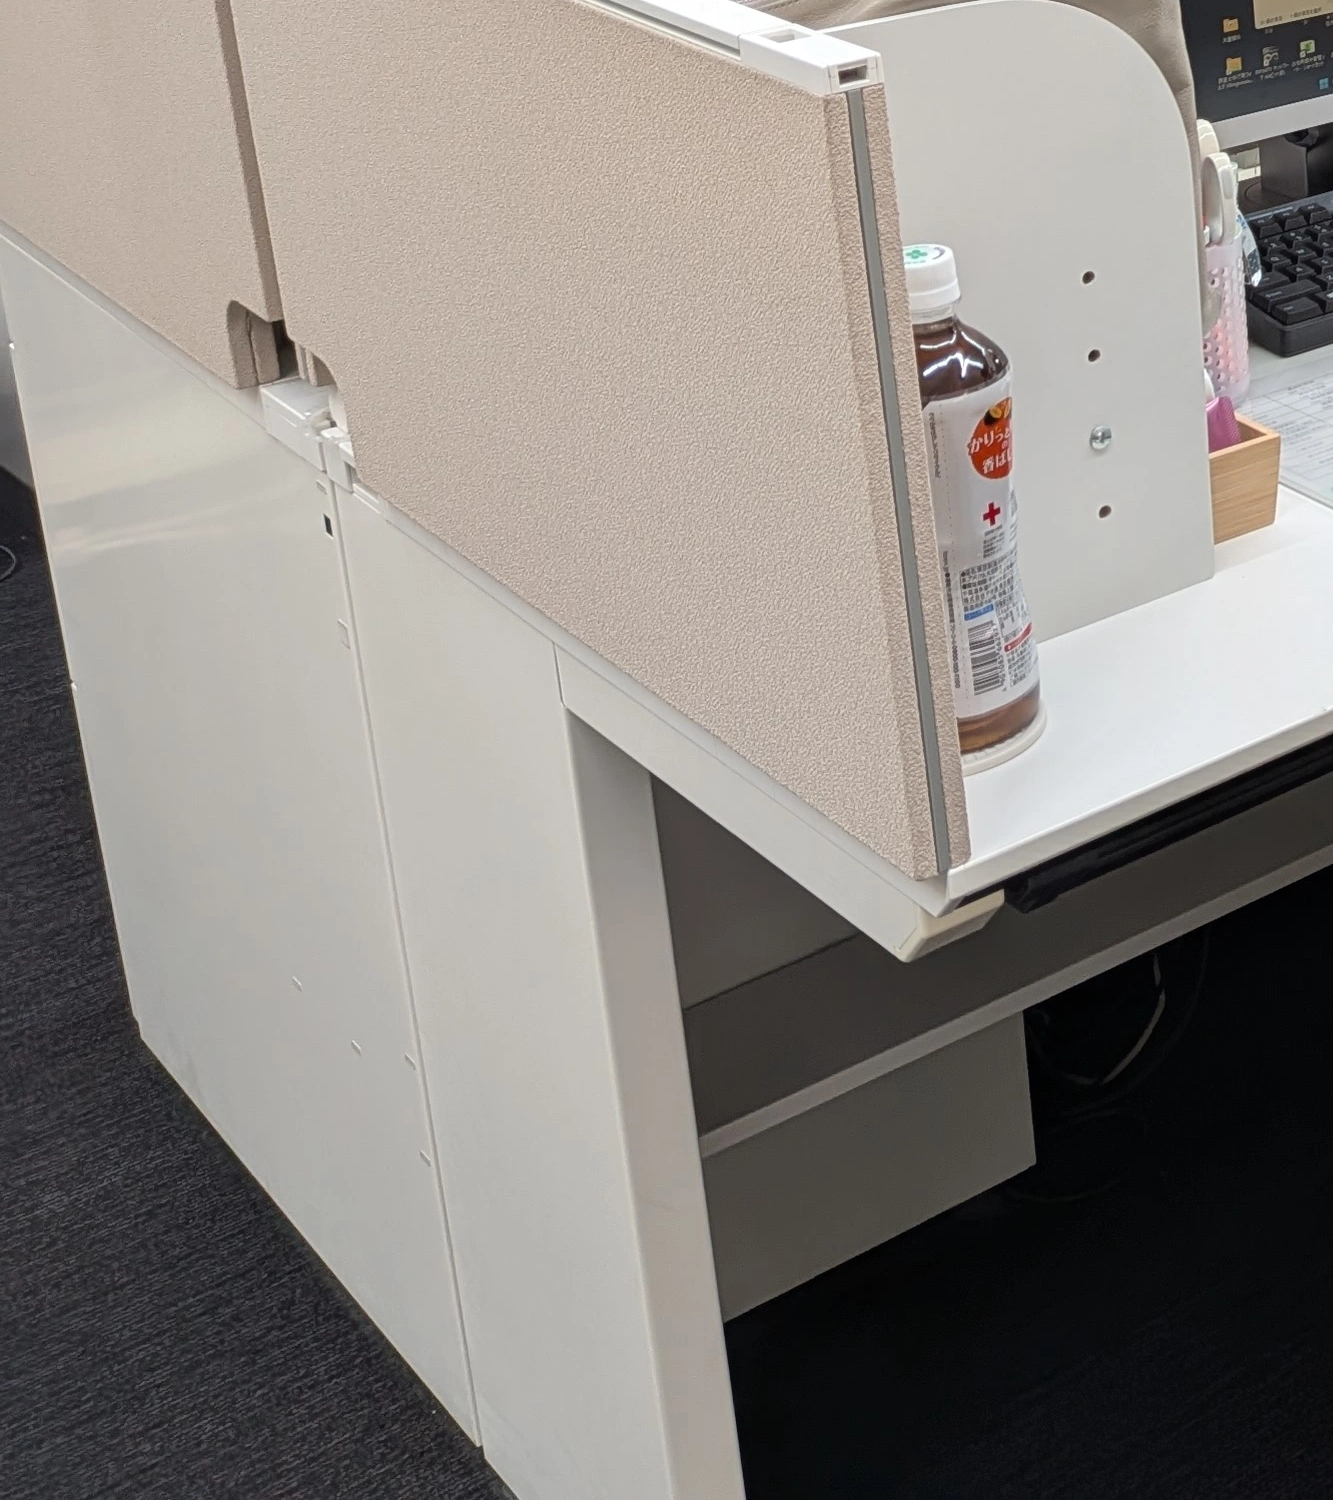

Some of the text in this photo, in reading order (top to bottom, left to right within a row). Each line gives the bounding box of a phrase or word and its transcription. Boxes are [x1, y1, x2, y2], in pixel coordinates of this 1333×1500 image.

[970, 428, 1010, 454] かりっと
[983, 449, 1011, 474] 香ばし
